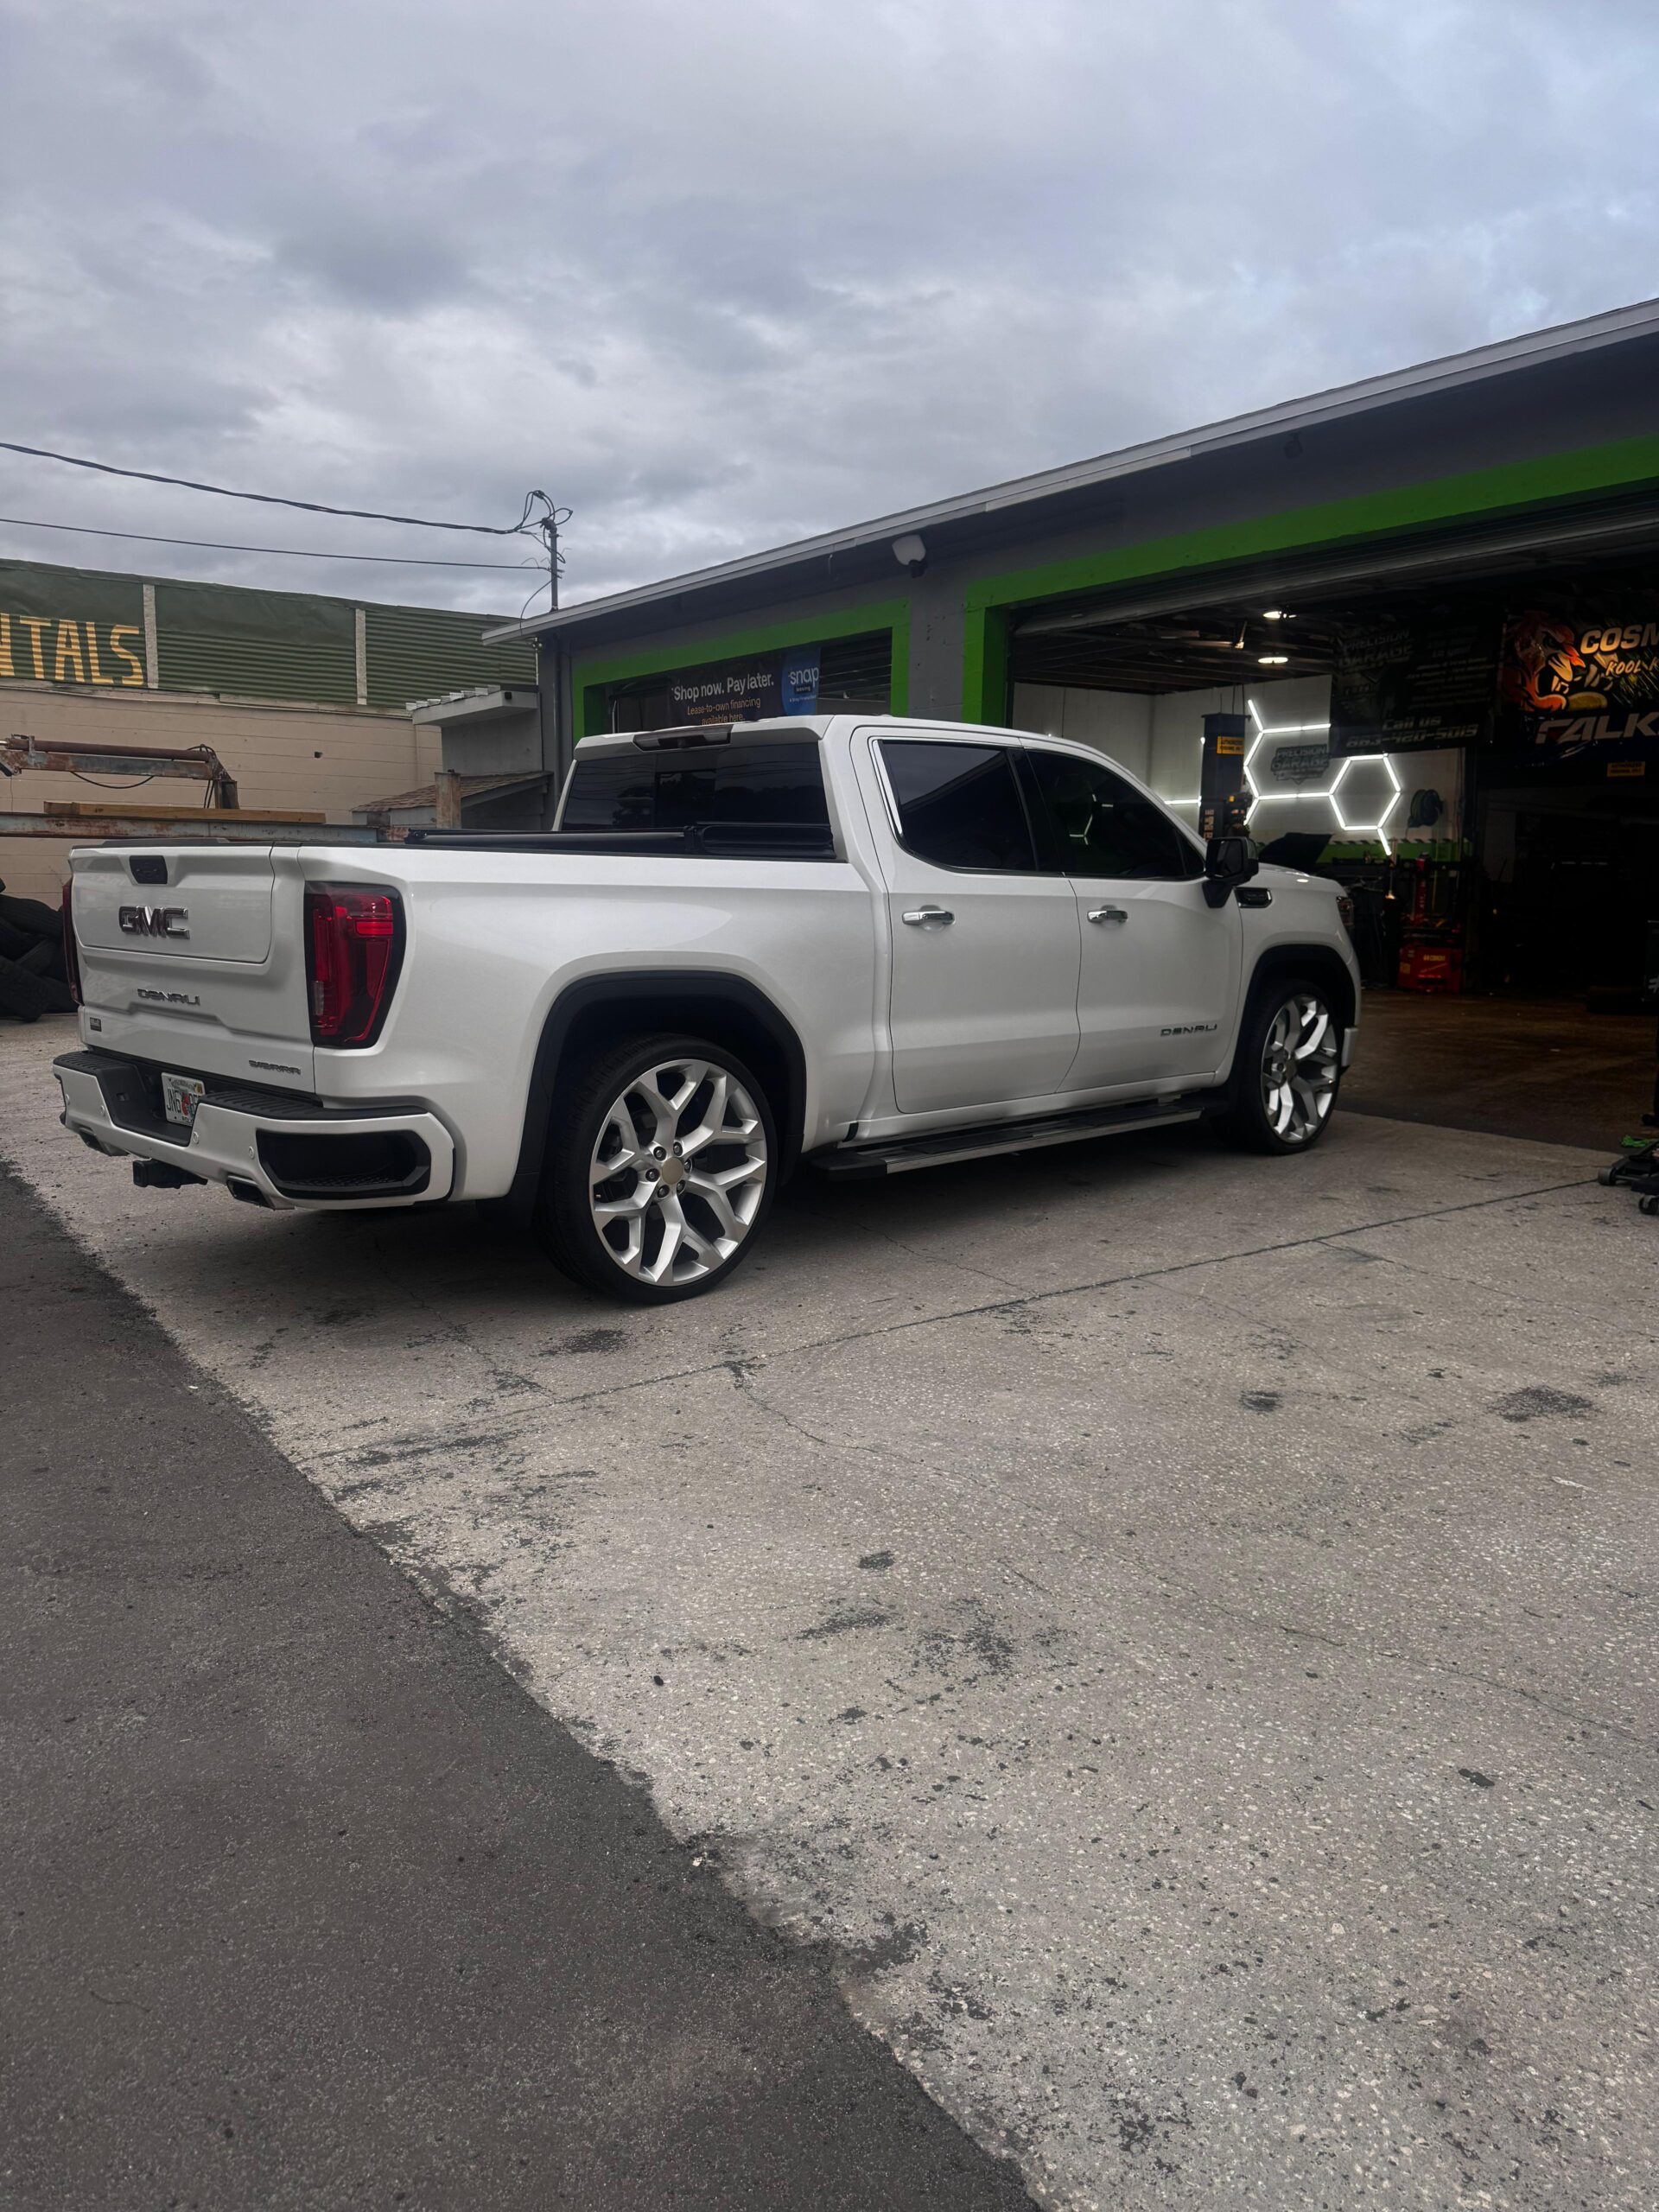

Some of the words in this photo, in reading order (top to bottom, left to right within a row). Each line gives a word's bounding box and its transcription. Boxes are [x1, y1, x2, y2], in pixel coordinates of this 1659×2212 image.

[1605, 659, 1642, 677] KOOL
[789, 667, 820, 688] snap
[673, 685, 699, 702] Shop
[701, 682, 724, 697] now.
[727, 677, 746, 695] Pay
[747, 672, 774, 690] later.
[687, 702, 729, 715] Lease-to-own
[730, 697, 761, 709] financing
[702, 714, 728, 725] available
[1382, 715, 1414, 731] Call
[1419, 715, 1442, 728] us
[1535, 712, 1659, 745] FALK
[1277, 745, 1328, 758] PRECISION
[1272, 755, 1329, 769] GARAGE
[118, 906, 190, 940] GMC
[137, 988, 200, 1007] DENALI
[1160, 1023, 1217, 1036] DENALI
